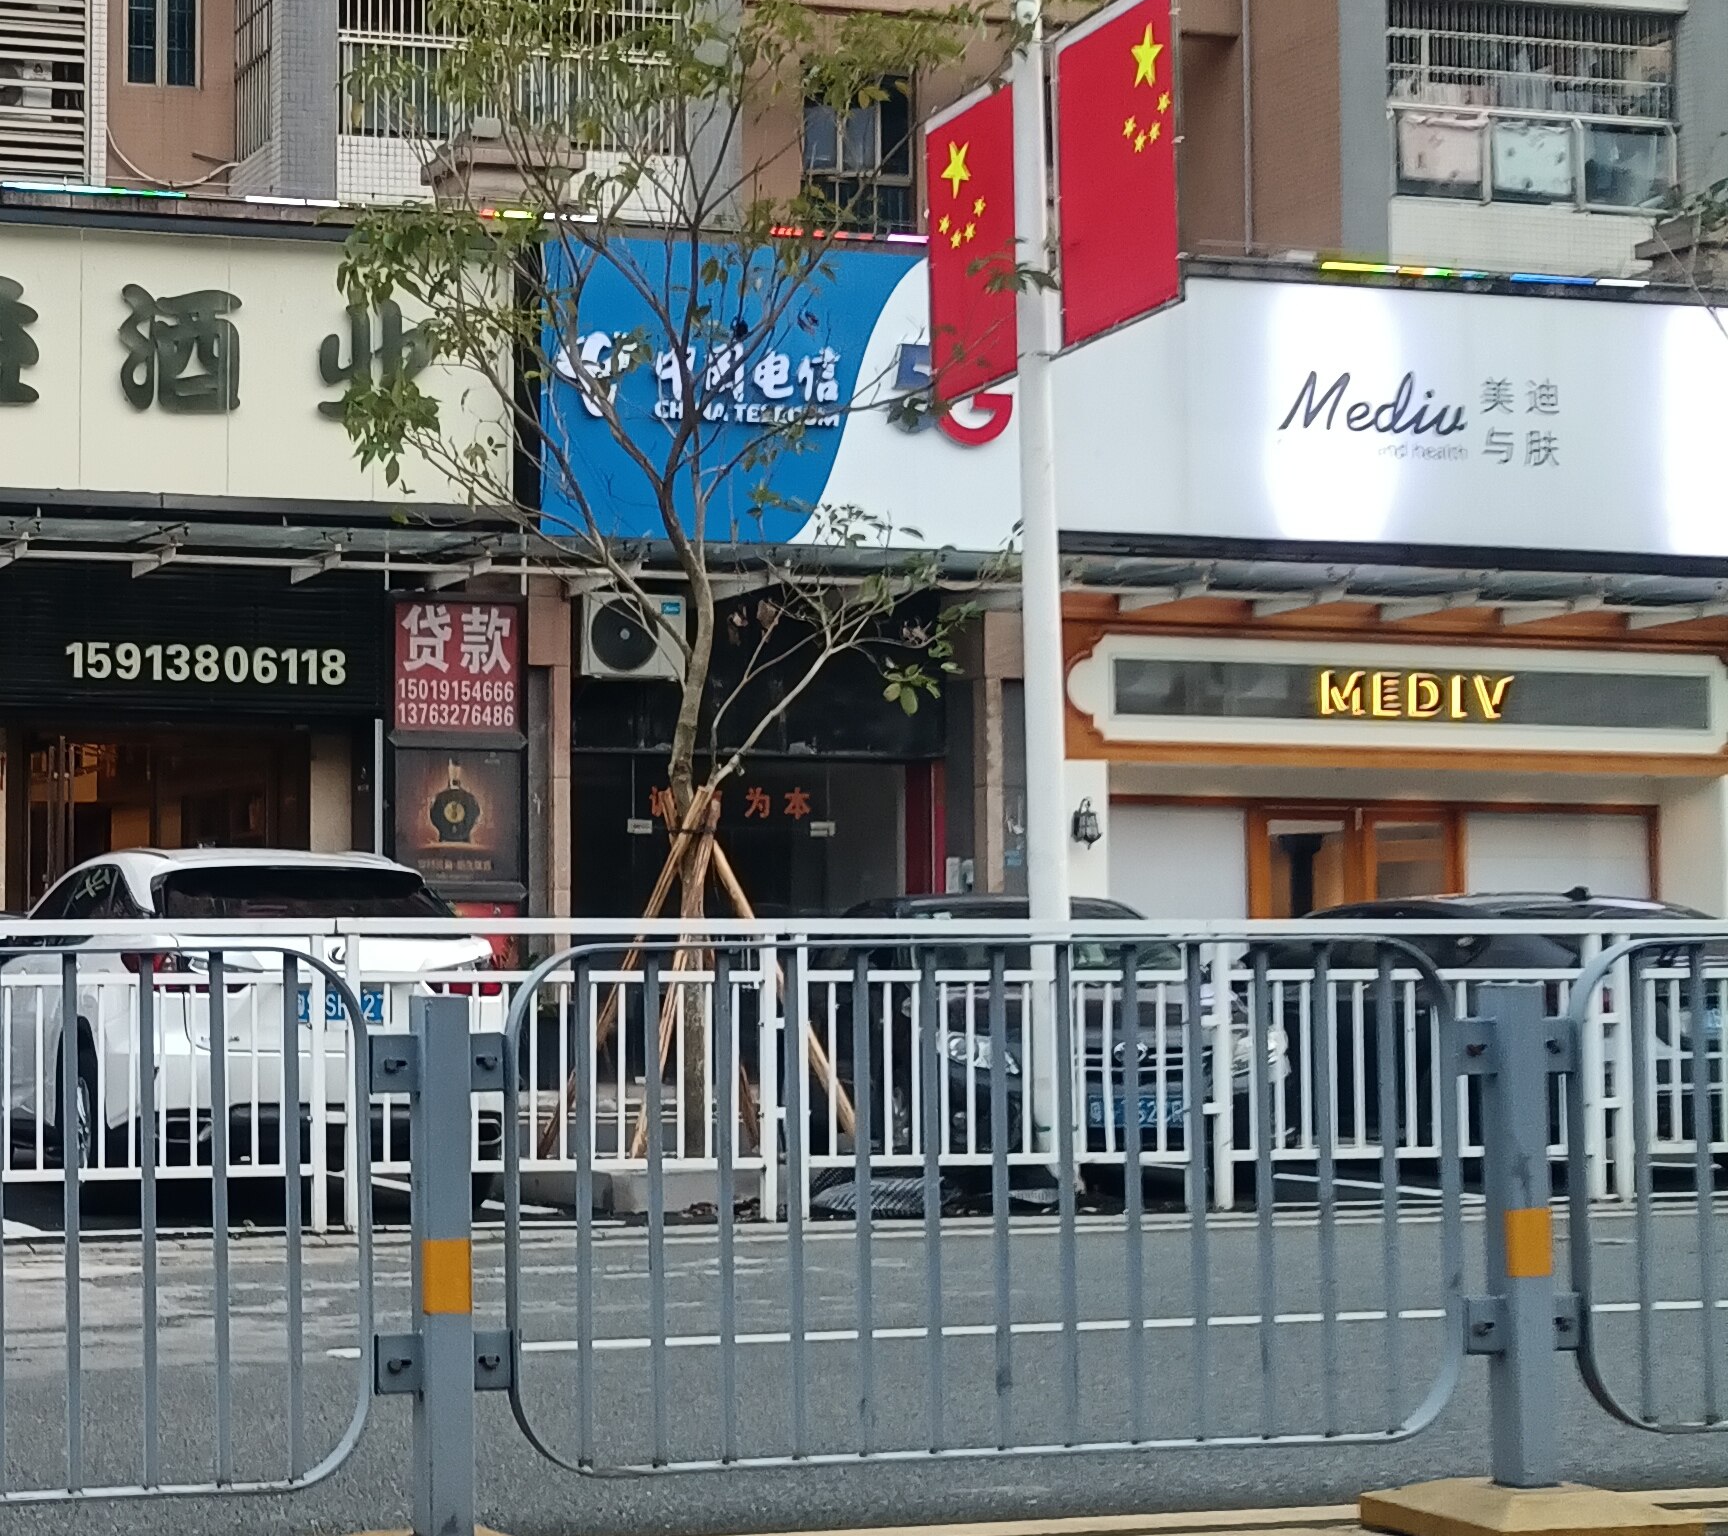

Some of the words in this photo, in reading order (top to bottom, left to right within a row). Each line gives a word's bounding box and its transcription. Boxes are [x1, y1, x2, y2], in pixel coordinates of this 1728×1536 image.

[1479, 376, 1560, 415] 美迪
[1481, 426, 1561, 467] 与肤
[400, 604, 512, 675] 贷款
[65, 642, 347, 685] 15913806118
[398, 678, 515, 703] 15019154666
[1320, 670, 1516, 719] MEDIV
[398, 702, 515, 727] 13763276486
